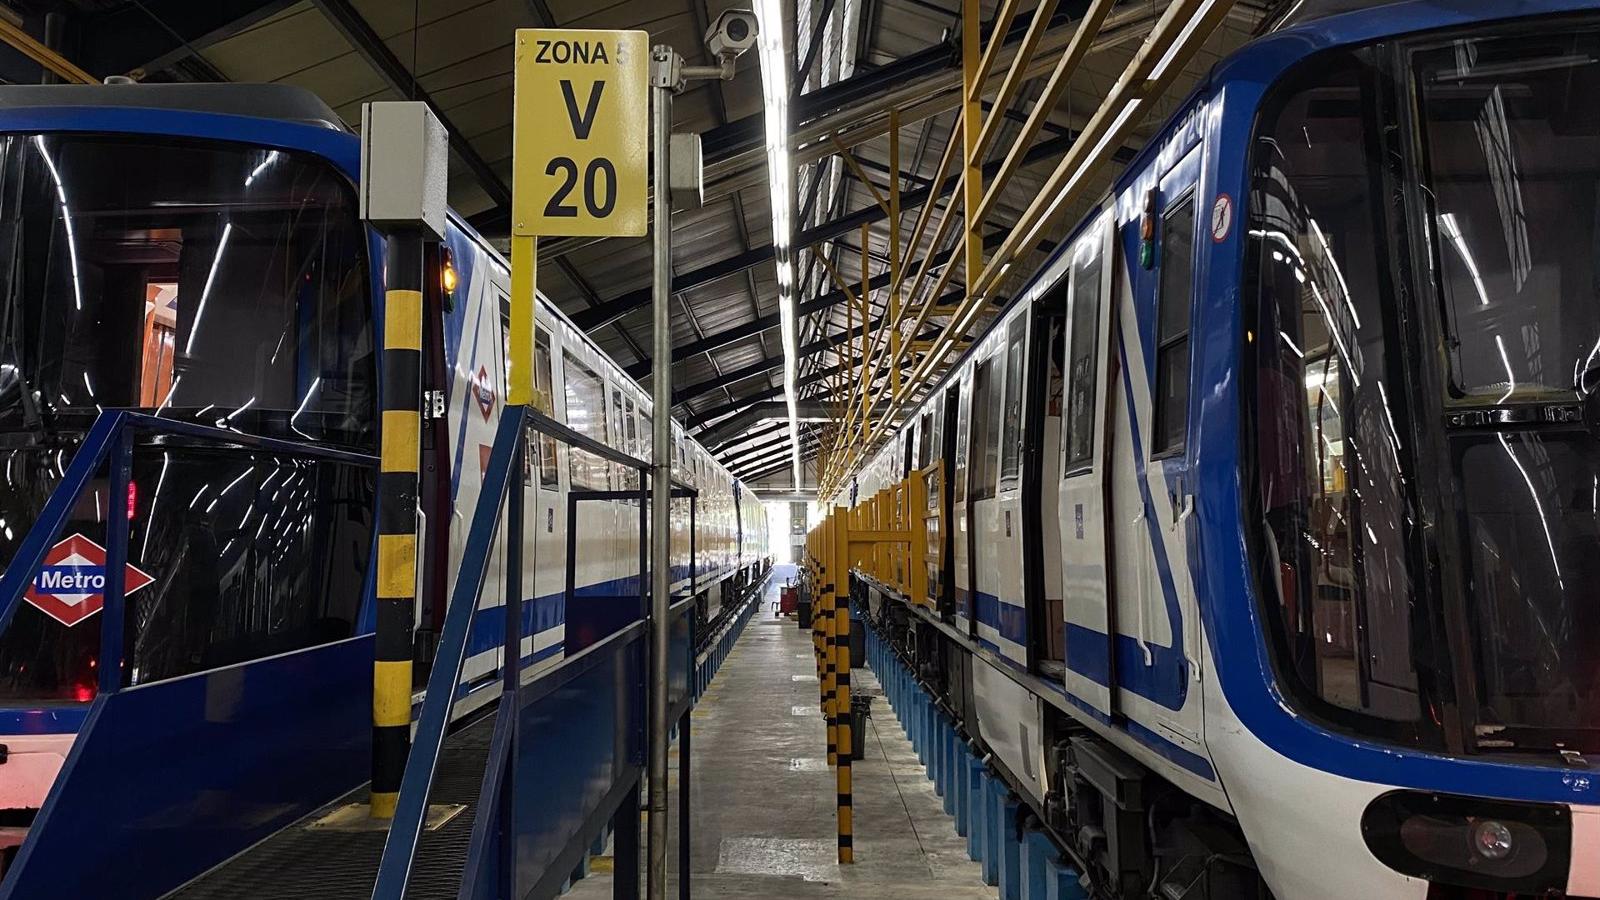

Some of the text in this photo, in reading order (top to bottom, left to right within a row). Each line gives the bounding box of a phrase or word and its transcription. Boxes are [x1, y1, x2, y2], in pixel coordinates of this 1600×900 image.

[535, 40, 609, 65] ZONA
[559, 79, 606, 140] V
[543, 156, 618, 219] 20
[41, 571, 105, 589] Metro
